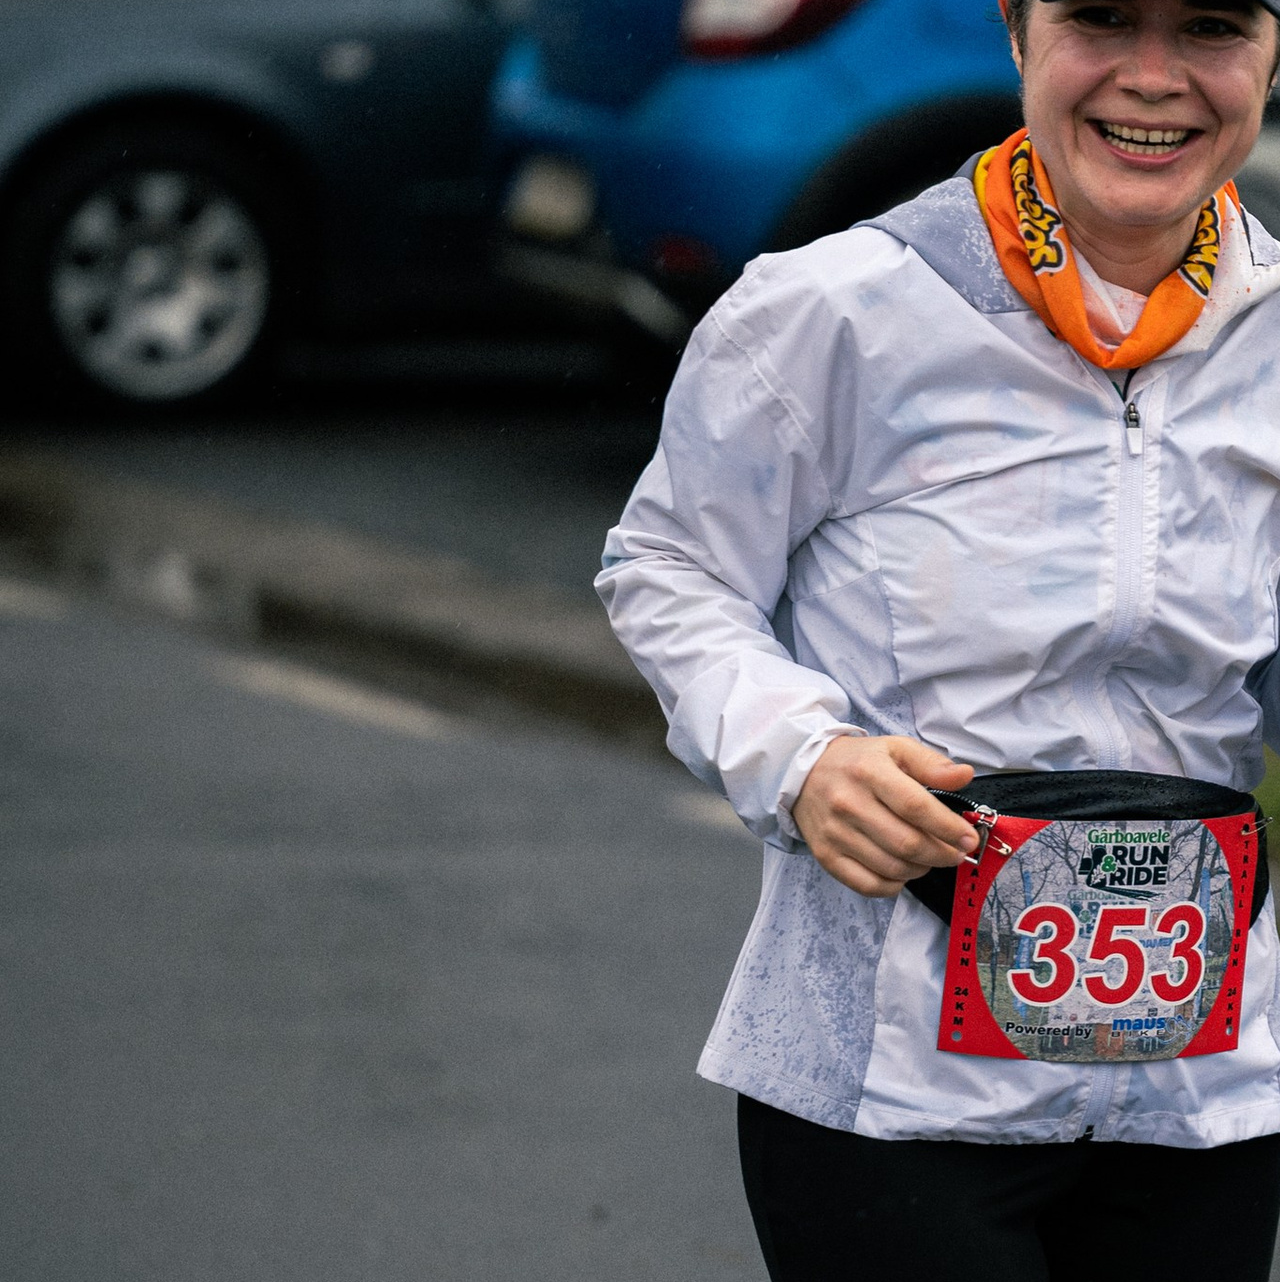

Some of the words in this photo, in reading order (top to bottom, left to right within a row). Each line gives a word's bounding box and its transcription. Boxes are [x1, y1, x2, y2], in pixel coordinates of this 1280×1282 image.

[1088, 828, 1170, 843] Gârboavele
[1101, 855, 1117, 873] &
[1111, 845, 1170, 866] RUN
[967, 853, 980, 908] AIL
[1108, 866, 1167, 886] RIDE
[1238, 840, 1250, 908] TRAIL
[960, 928, 973, 967] RUN
[1009, 901, 1206, 1007] 353
[1231, 928, 1241, 967] RUN
[954, 987, 969, 997] 24
[1005, 1022, 1074, 1037] Powered
[1075, 1026, 1092, 1038] by
[1112, 1017, 1166, 1031] maus
